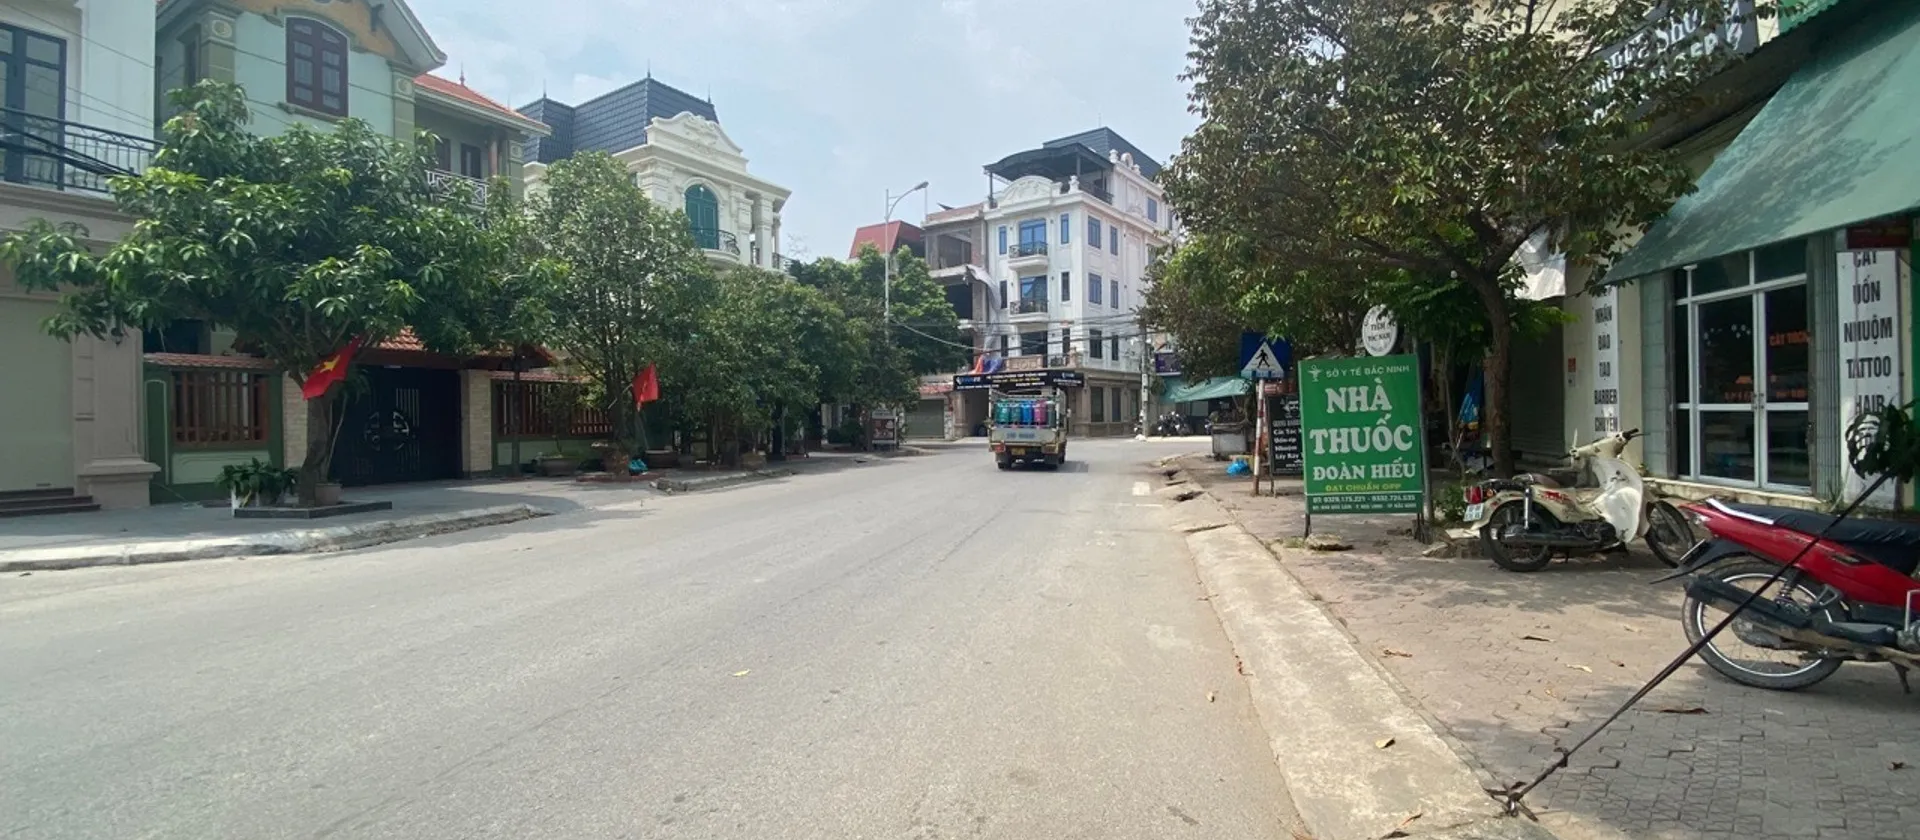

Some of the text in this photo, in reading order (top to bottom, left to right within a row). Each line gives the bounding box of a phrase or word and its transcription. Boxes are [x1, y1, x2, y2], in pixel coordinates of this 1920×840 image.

[1853, 275, 1881, 304] UỐN
[1844, 315, 1893, 344] NHUỘM
[1326, 363, 1410, 378] SỞ Y TẾ BẮC NINH
[1846, 355, 1892, 379] TATTOO
[1325, 377, 1393, 413] NHÀ
[1594, 388, 1617, 405] BARBER
[1309, 414, 1413, 455] THUỐC
[1312, 456, 1416, 481] ĐOÀN HIẾU
